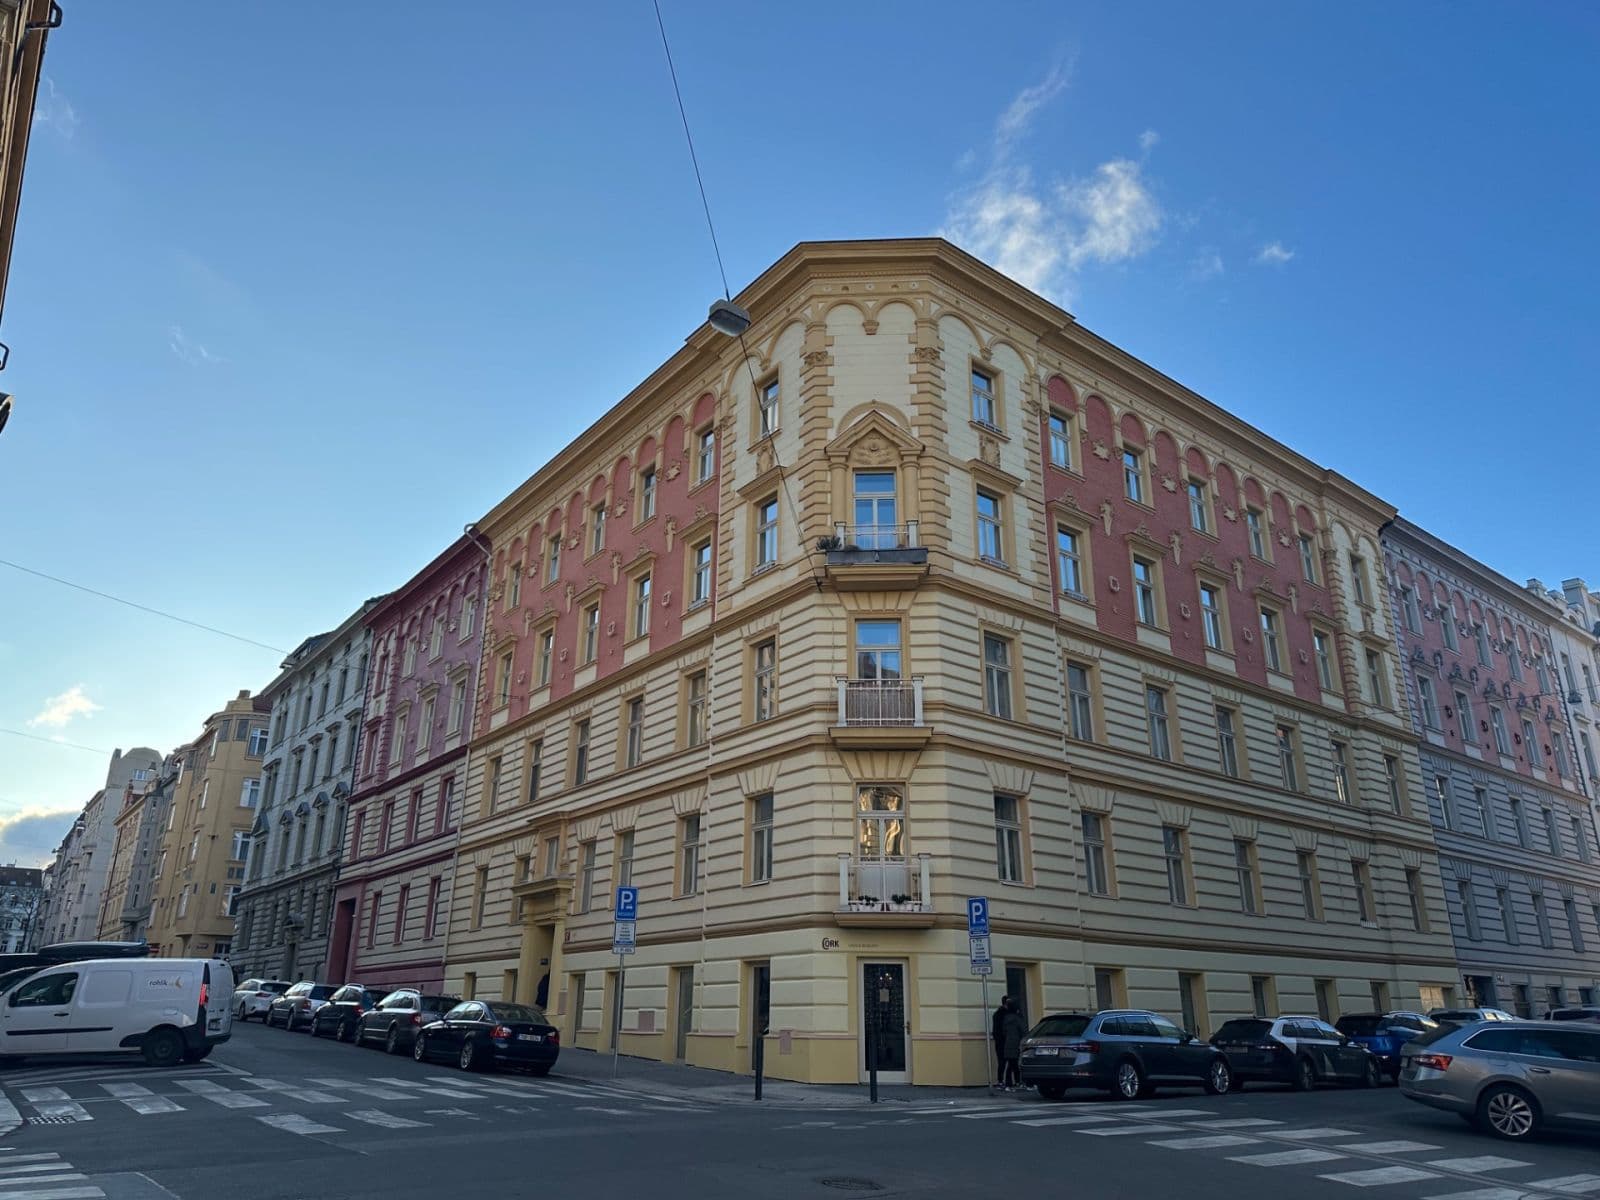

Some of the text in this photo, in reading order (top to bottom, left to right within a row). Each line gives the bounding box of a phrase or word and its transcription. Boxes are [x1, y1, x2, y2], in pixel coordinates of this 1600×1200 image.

[621, 891, 633, 910] P
[971, 902, 983, 924] P
[822, 937, 840, 950] CORK
[149, 979, 169, 987] rohlik
